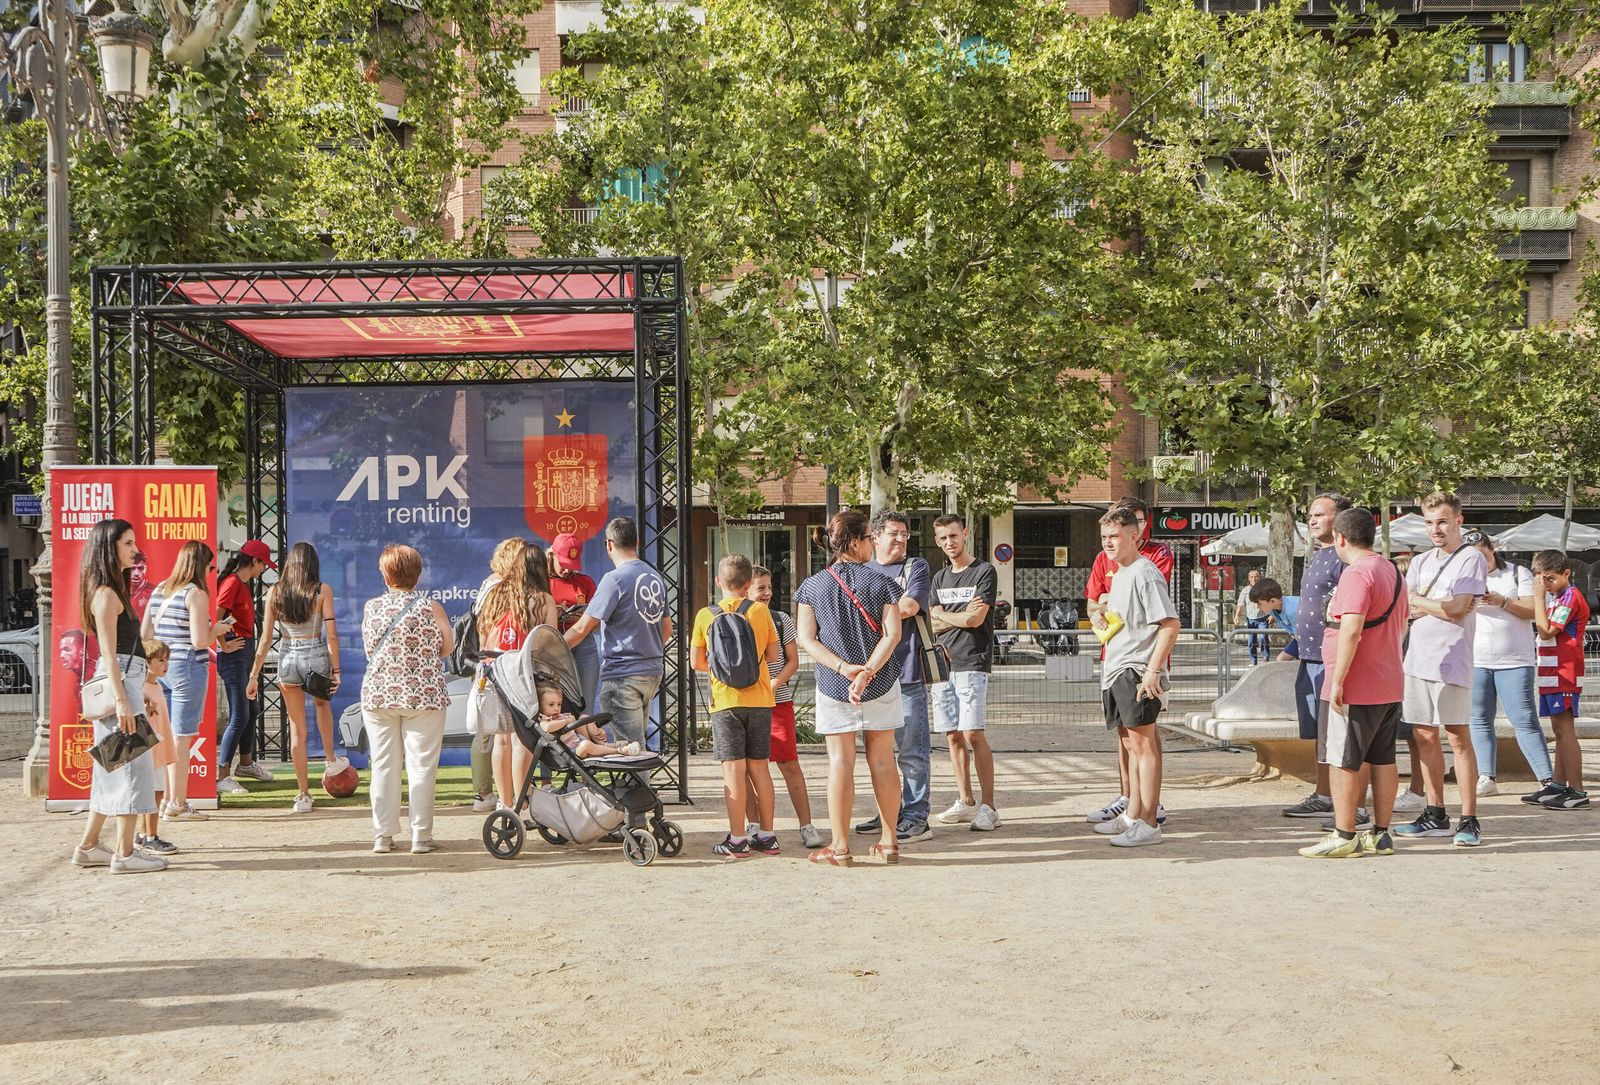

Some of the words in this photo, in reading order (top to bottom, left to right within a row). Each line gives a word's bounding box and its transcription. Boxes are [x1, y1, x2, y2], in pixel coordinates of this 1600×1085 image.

[336, 455, 470, 501] APK
[61, 483, 114, 512] JUEGA
[144, 482, 207, 518] GANA
[61, 512, 68, 524] A
[68, 512, 78, 524] LA
[79, 512, 104, 524] RULETA
[387, 502, 470, 528] renting
[746, 510, 785, 520] ncial
[62, 527, 72, 540] LA
[145, 522, 159, 540] TU
[162, 522, 207, 540] PREMIO
